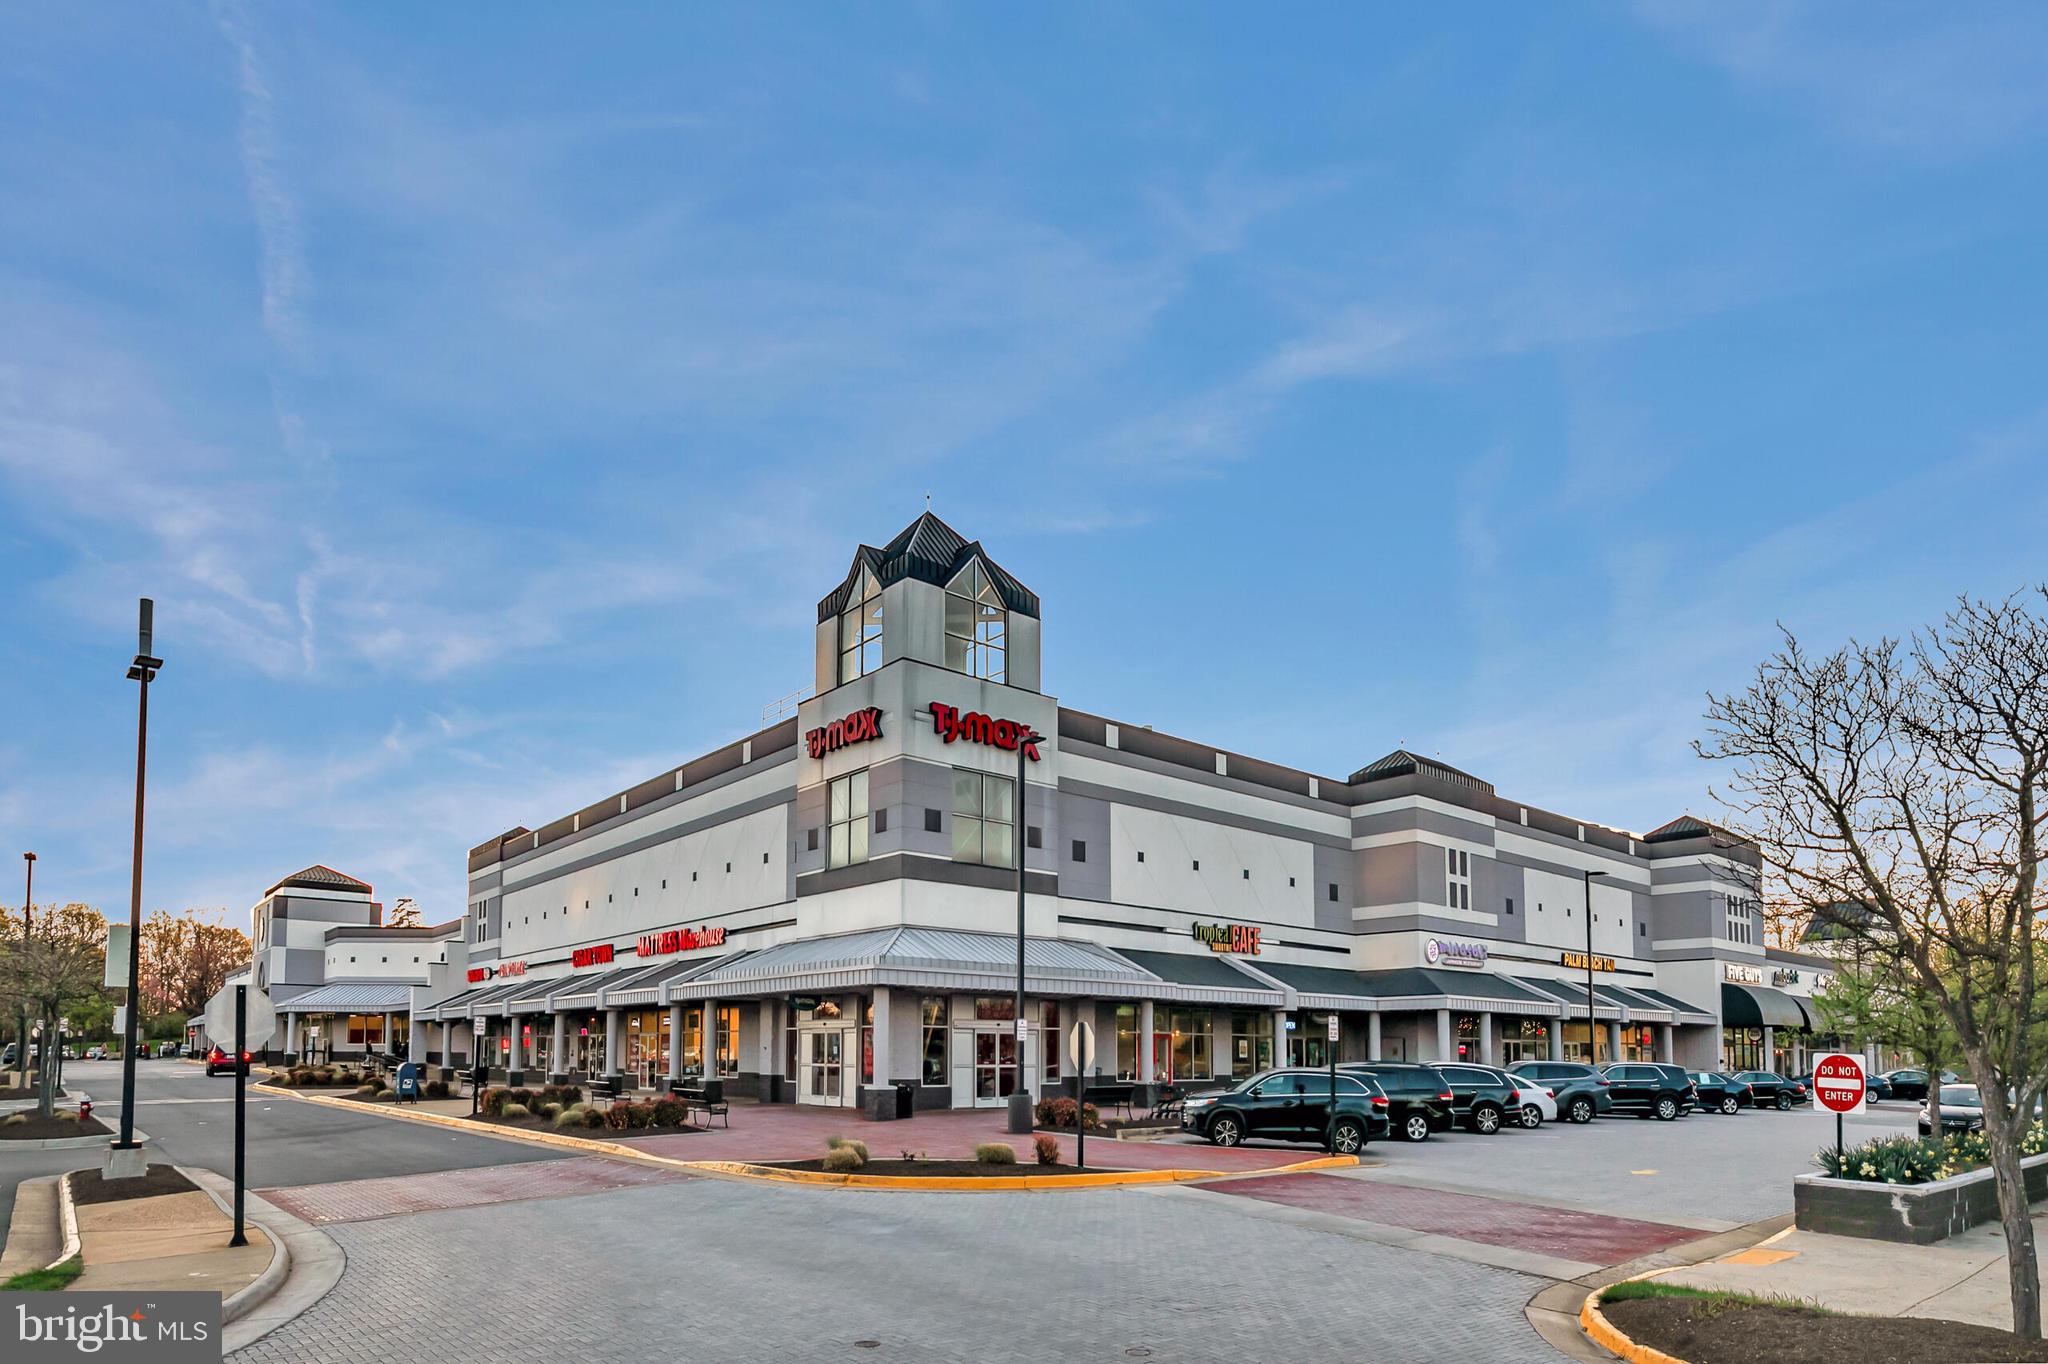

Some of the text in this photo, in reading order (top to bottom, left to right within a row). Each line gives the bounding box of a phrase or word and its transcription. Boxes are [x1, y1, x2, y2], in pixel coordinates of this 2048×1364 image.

[636, 925, 726, 957] MATTRESS Warehouse
[1232, 924, 1261, 954] CAFE
[1563, 953, 1582, 968] PALM
[1603, 958, 1616, 972] TAN
[1726, 964, 1744, 982] FIVE
[1744, 966, 1762, 984] GUYS
[1821, 1065, 1857, 1076] DO NOT
[1825, 1091, 1854, 1102] ENTER
